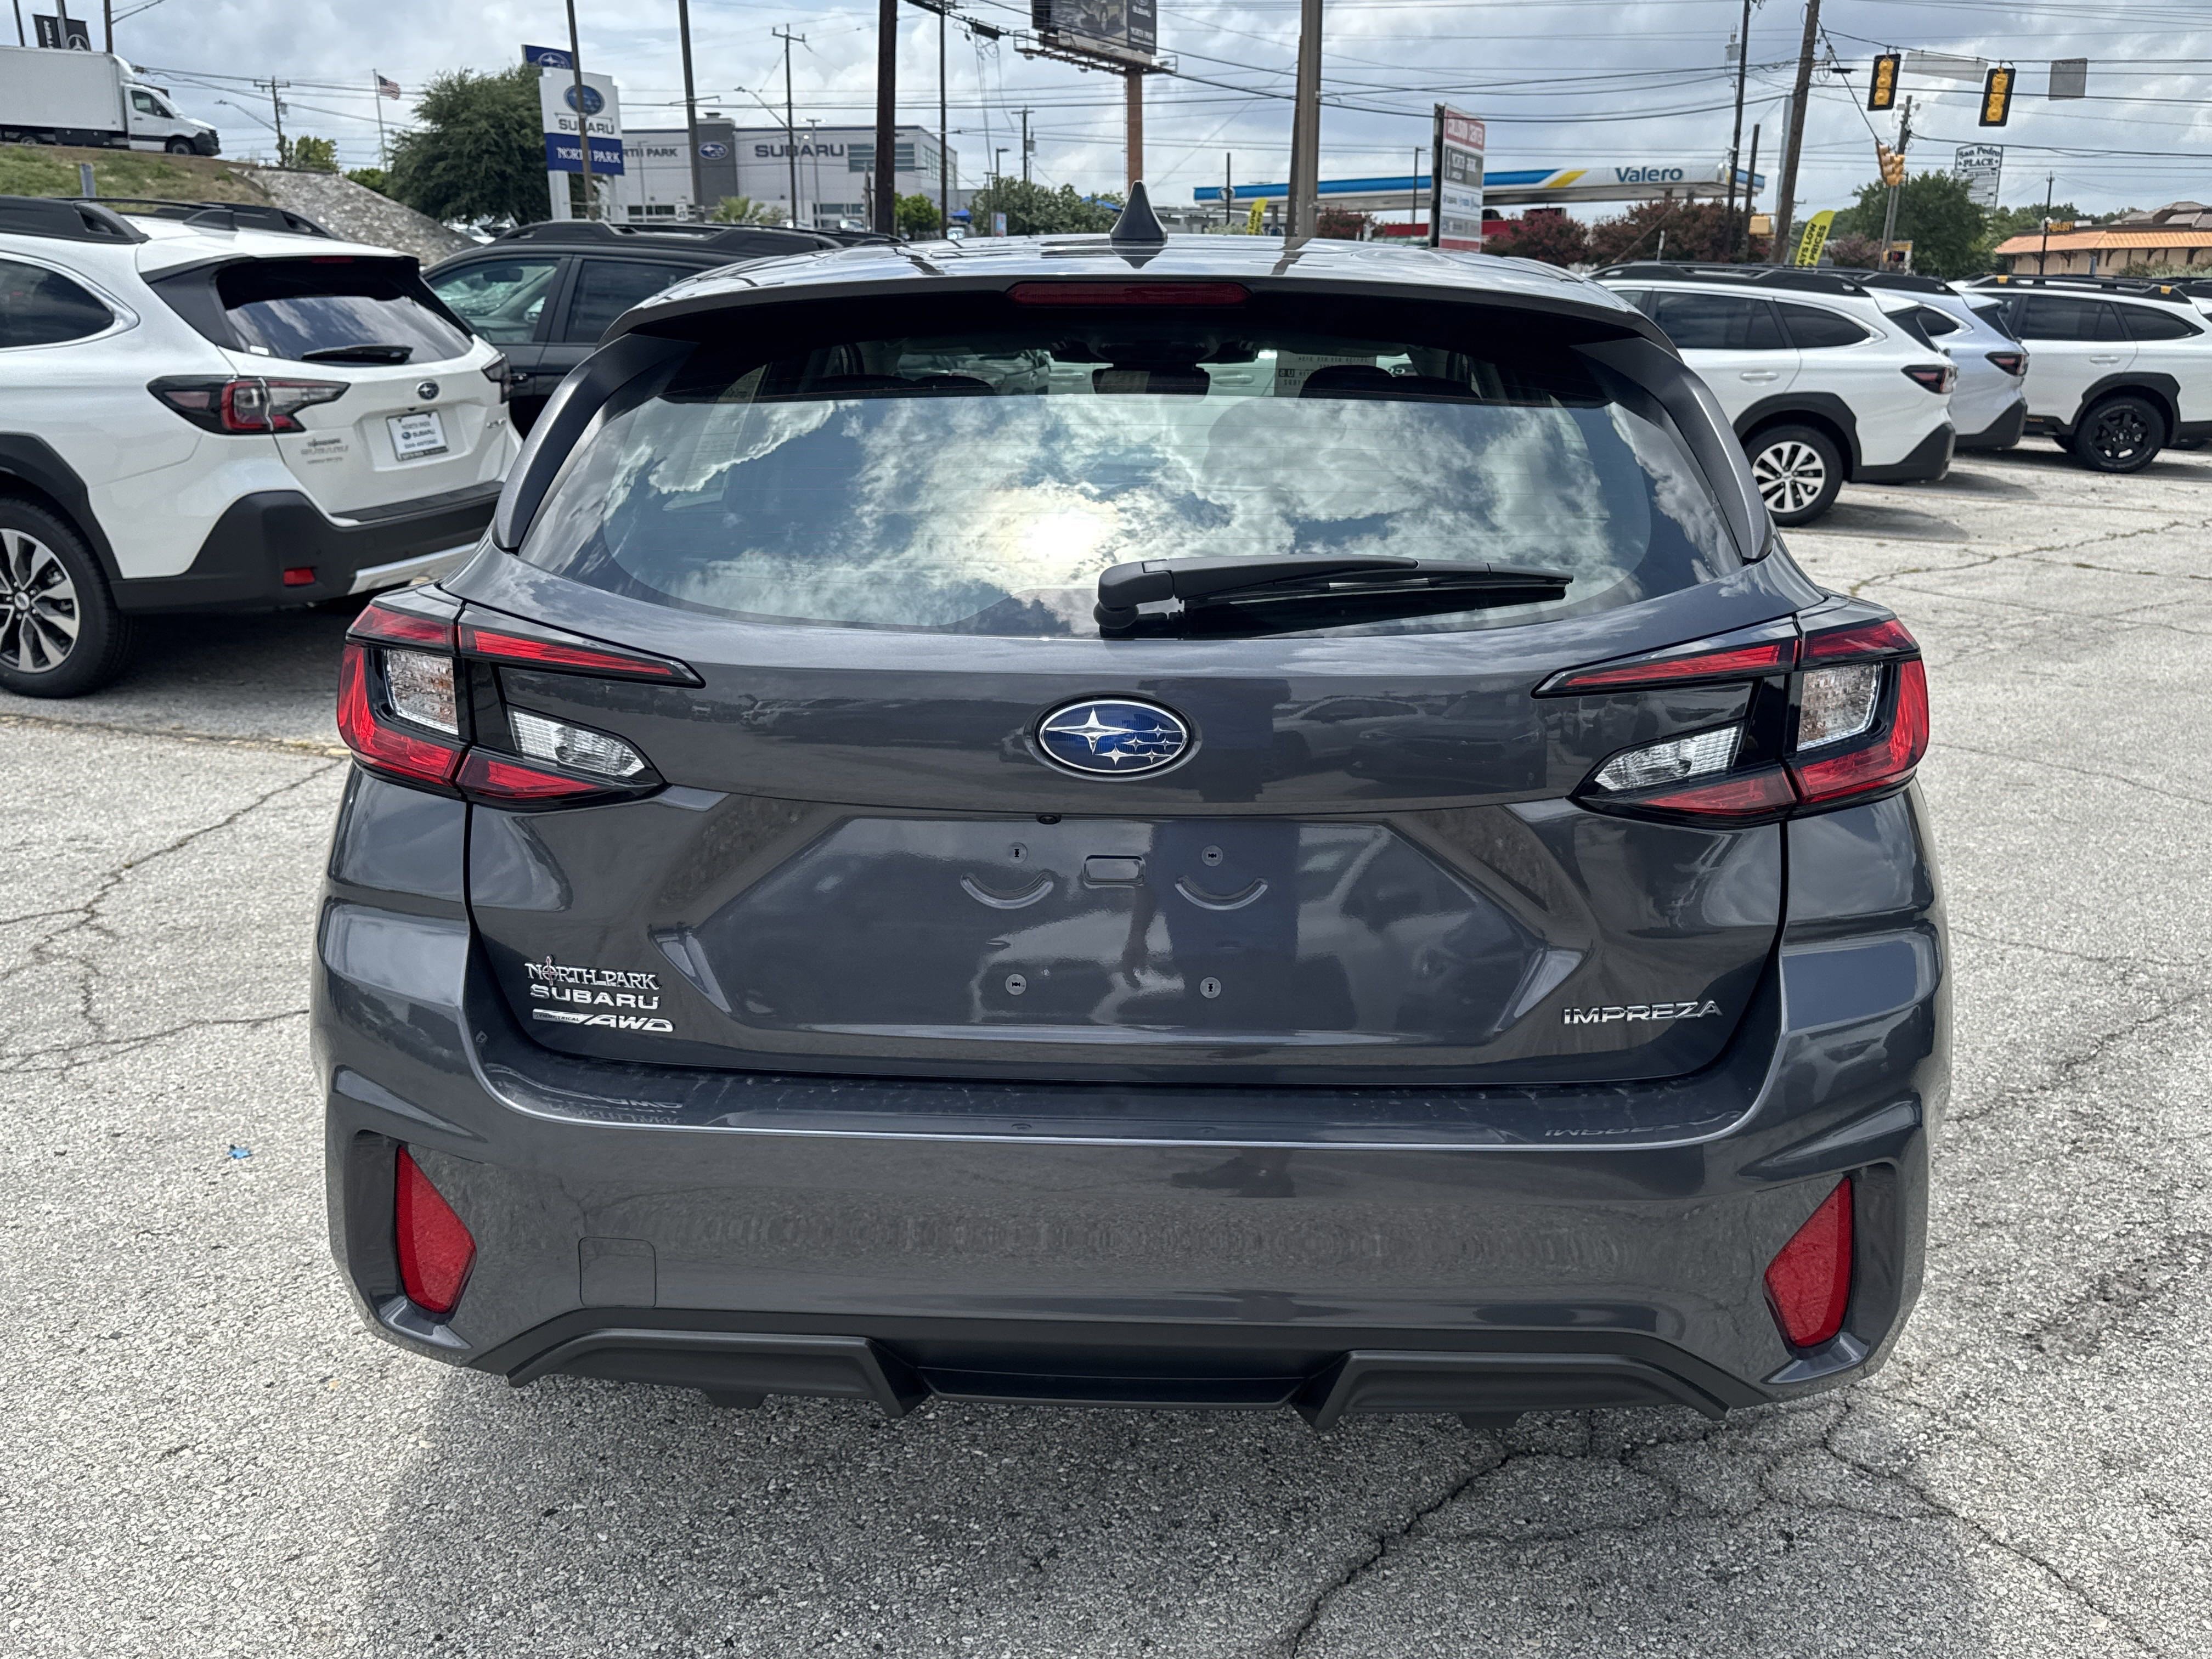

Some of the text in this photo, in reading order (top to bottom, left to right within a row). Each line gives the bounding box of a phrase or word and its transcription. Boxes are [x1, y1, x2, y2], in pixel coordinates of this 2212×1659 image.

[558, 119, 614, 134] SUARU
[593, 150, 620, 163] PARK
[647, 148, 678, 157] PARK
[755, 144, 844, 157] SUBARU
[1963, 157, 1994, 167] PLACE
[1615, 166, 1683, 182] Valero
[1804, 223, 1816, 245] LOW
[1809, 225, 1826, 261] PRICES
[524, 962, 661, 990] NORTH PARK
[529, 984, 660, 1009] SUBARU
[1564, 1000, 1723, 1024] IMPREZA
[584, 1014, 674, 1032] AWD
